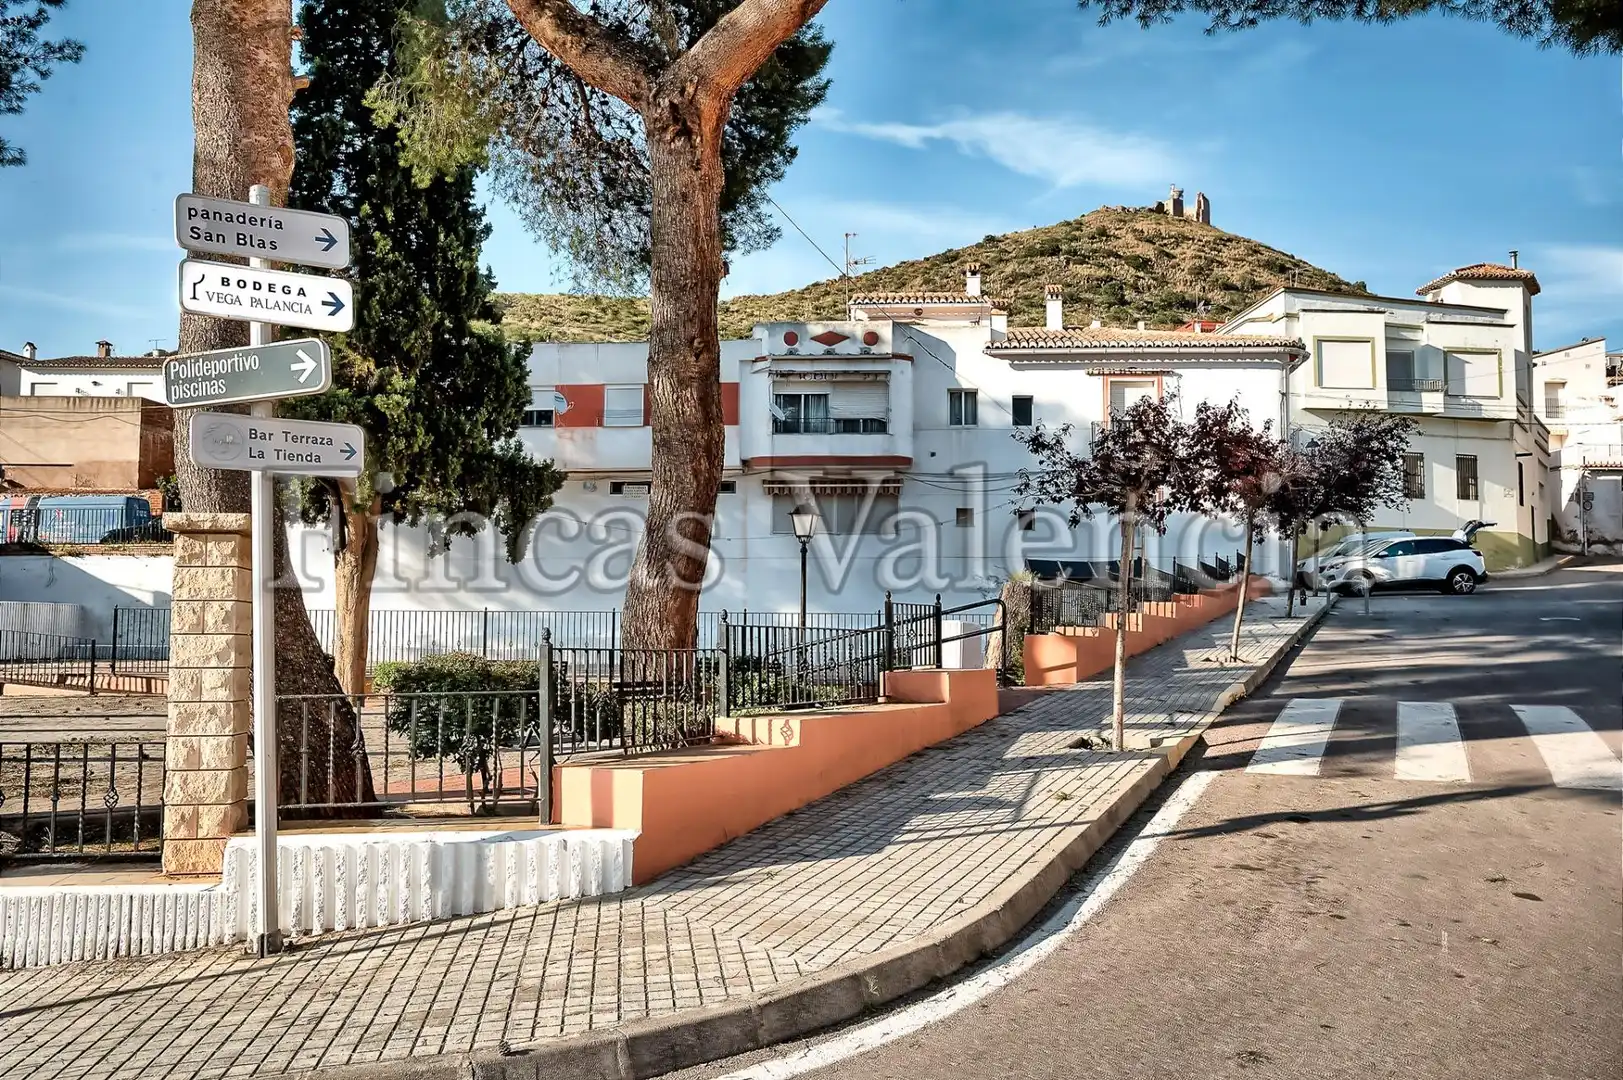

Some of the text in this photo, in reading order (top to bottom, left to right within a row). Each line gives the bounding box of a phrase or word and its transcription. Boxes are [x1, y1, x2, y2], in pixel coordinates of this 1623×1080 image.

[187, 206, 284, 231] panadería
[189, 226, 278, 250] San Blas
[221, 276, 307, 297] BODEGA
[206, 290, 313, 315] VEGA PALANCIA
[170, 353, 259, 379] Polideportivo
[171, 378, 226, 402] piscinas
[249, 428, 274, 441] Bar
[282, 430, 334, 446] Terraza
[249, 447, 321, 463] La Tienda
